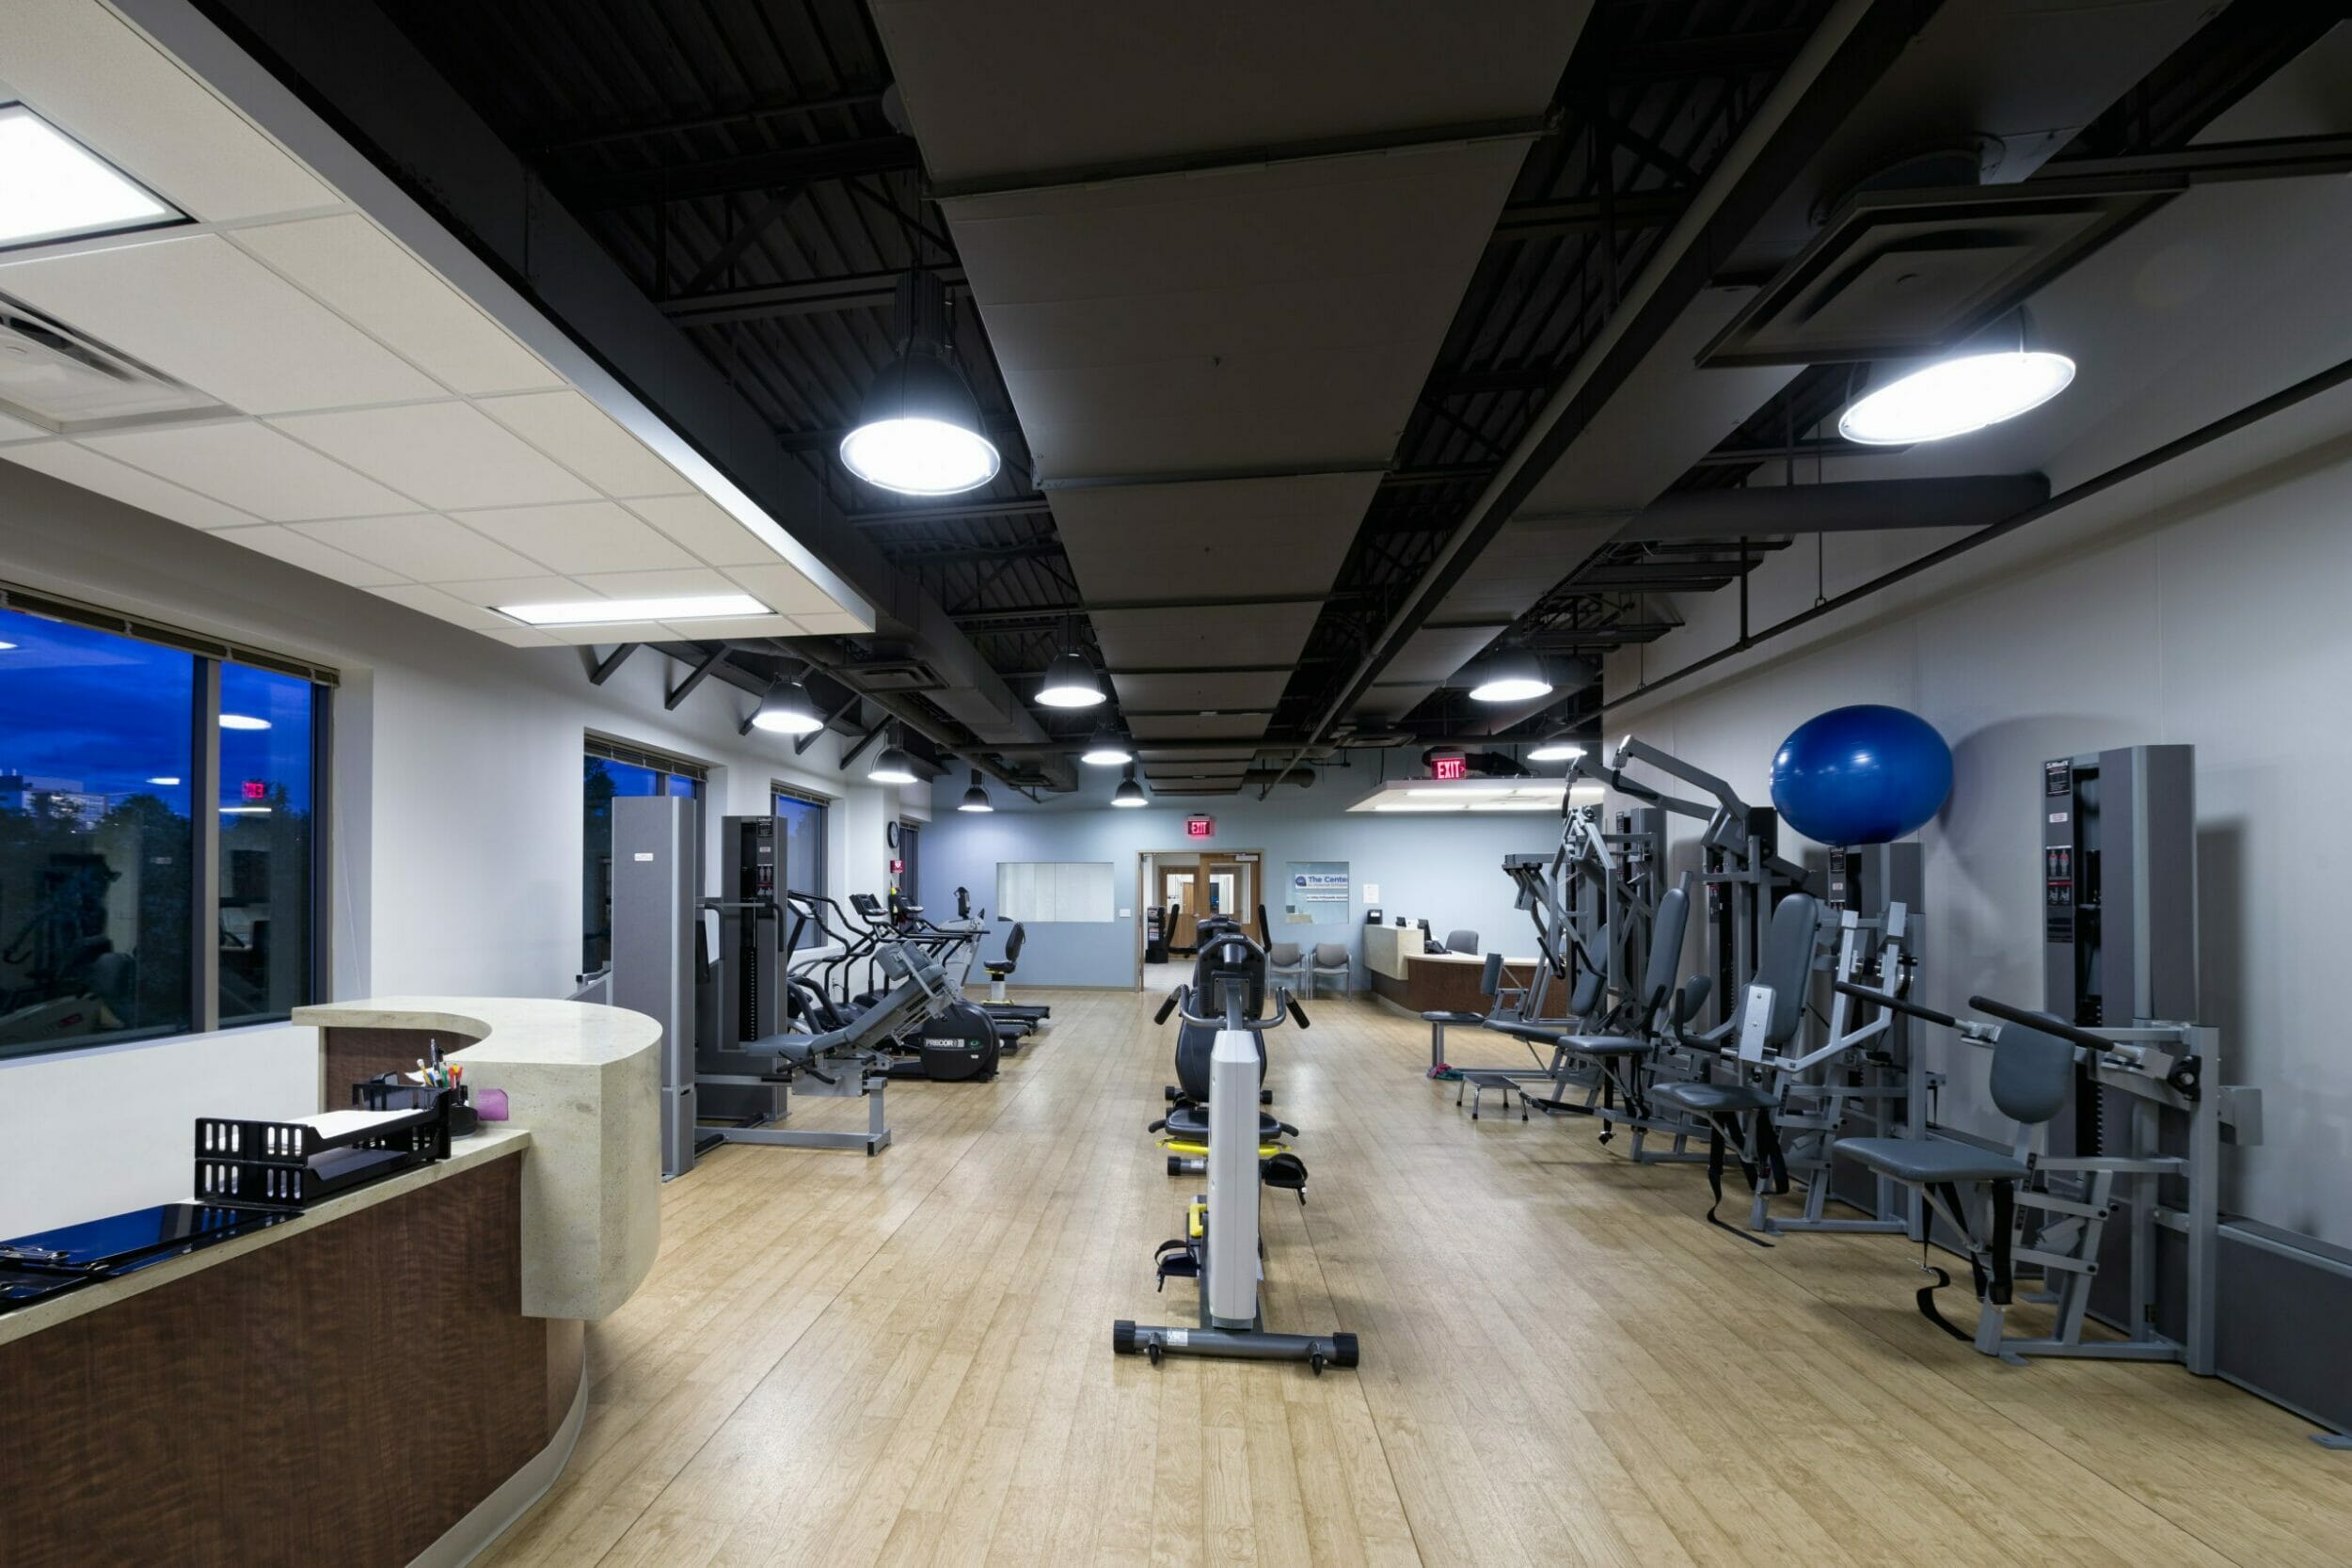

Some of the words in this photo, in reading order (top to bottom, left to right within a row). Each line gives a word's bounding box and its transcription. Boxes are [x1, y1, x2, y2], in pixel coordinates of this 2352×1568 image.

[1437, 761, 1460, 779] EXIT
[1191, 822, 1207, 834] EXIT
[925, 1038, 954, 1048] PRECOR
